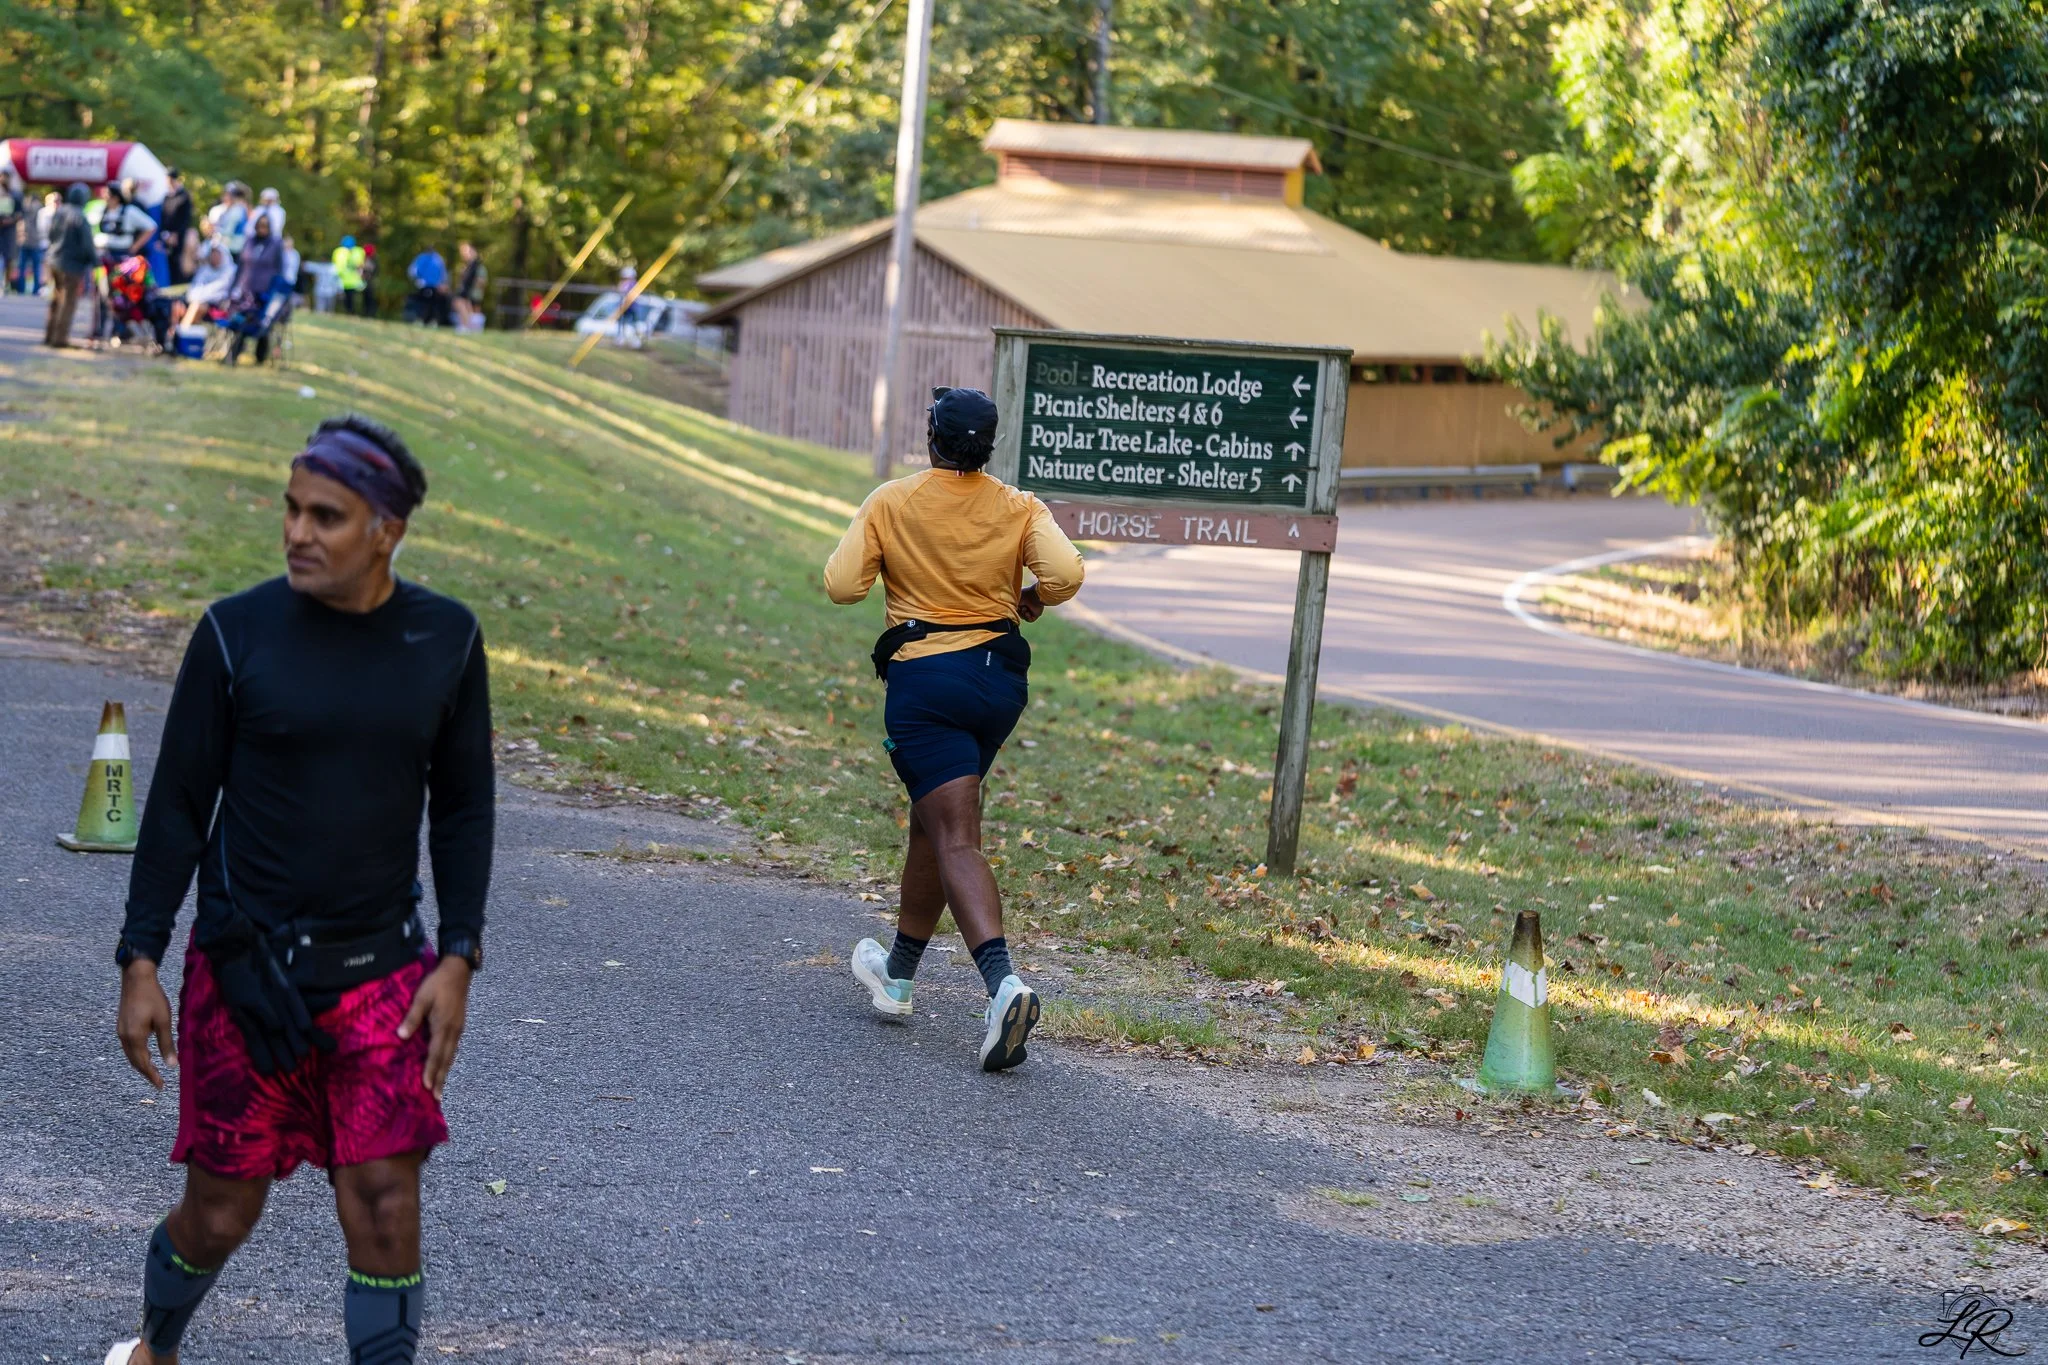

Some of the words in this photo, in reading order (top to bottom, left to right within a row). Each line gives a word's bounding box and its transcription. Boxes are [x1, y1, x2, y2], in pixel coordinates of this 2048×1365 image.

[1035, 361, 1078, 386] Pool
[1091, 365, 1198, 394] Recreation
[1201, 370, 1263, 404] Lodge
[1033, 392, 1094, 419] Picnic
[1095, 393, 1176, 423] Shelters
[1030, 423, 1095, 455] Poplar
[1098, 427, 1142, 453] Tree
[1144, 428, 1193, 456] Lake
[1205, 431, 1273, 460] Cabins
[1027, 455, 1095, 481] Nature
[1098, 458, 1165, 485] Center
[1177, 460, 1248, 490] Shelter
[1249, 467, 1263, 493] 5
[1078, 510, 1162, 539] HORSE
[1180, 516, 1258, 544] TRAIL
